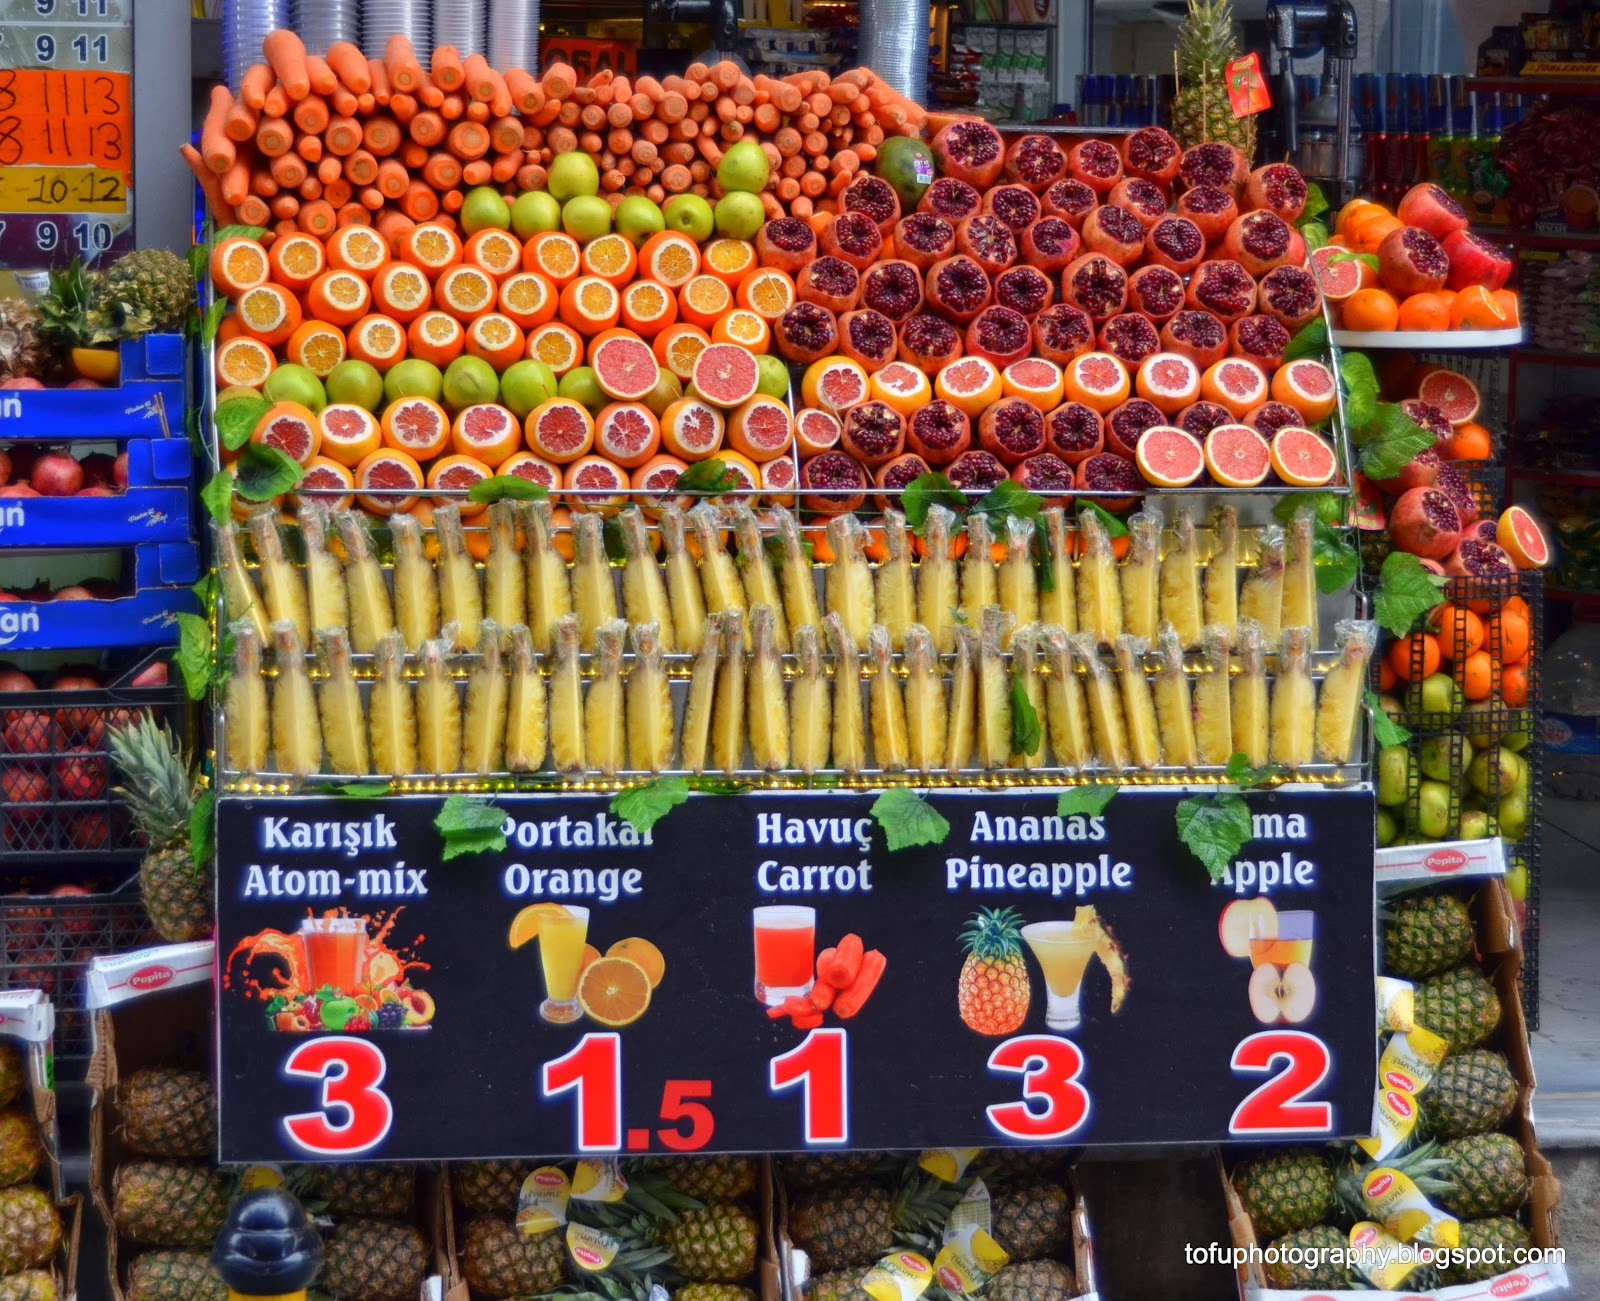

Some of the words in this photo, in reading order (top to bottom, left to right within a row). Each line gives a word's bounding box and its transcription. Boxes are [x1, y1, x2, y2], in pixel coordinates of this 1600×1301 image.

[35, 33, 56, 63] 9
[72, 34, 107, 63] 11
[37, 221, 58, 251] 9
[73, 221, 113, 251] 10
[264, 813, 398, 856] Karışık
[757, 812, 873, 852] Havuç
[969, 811, 1107, 842] Ananas
[1252, 813, 1307, 839] ma
[757, 859, 873, 891] Carrot
[945, 854, 1133, 896] Pineapple
[1427, 855, 1464, 867] Pepita
[244, 861, 428, 897] Atom-mix
[504, 863, 643, 901] Orange
[132, 971, 171, 986] Pepita
[284, 1036, 393, 1154] 3
[770, 1027, 848, 1143] 1
[986, 1034, 1091, 1141] 3
[1228, 1030, 1333, 1135] 2
[1387, 1073, 1413, 1092] Pepita
[1378, 1103, 1402, 1131] NEAPPLE
[1388, 1091, 1410, 1115] Pepita
[535, 1174, 562, 1184] Pepita
[1367, 1176, 1392, 1197] Pepita
[574, 1247, 602, 1264] Pepita
[940, 1266, 962, 1291] Pepita
[1491, 1277, 1528, 1294] Pepita
